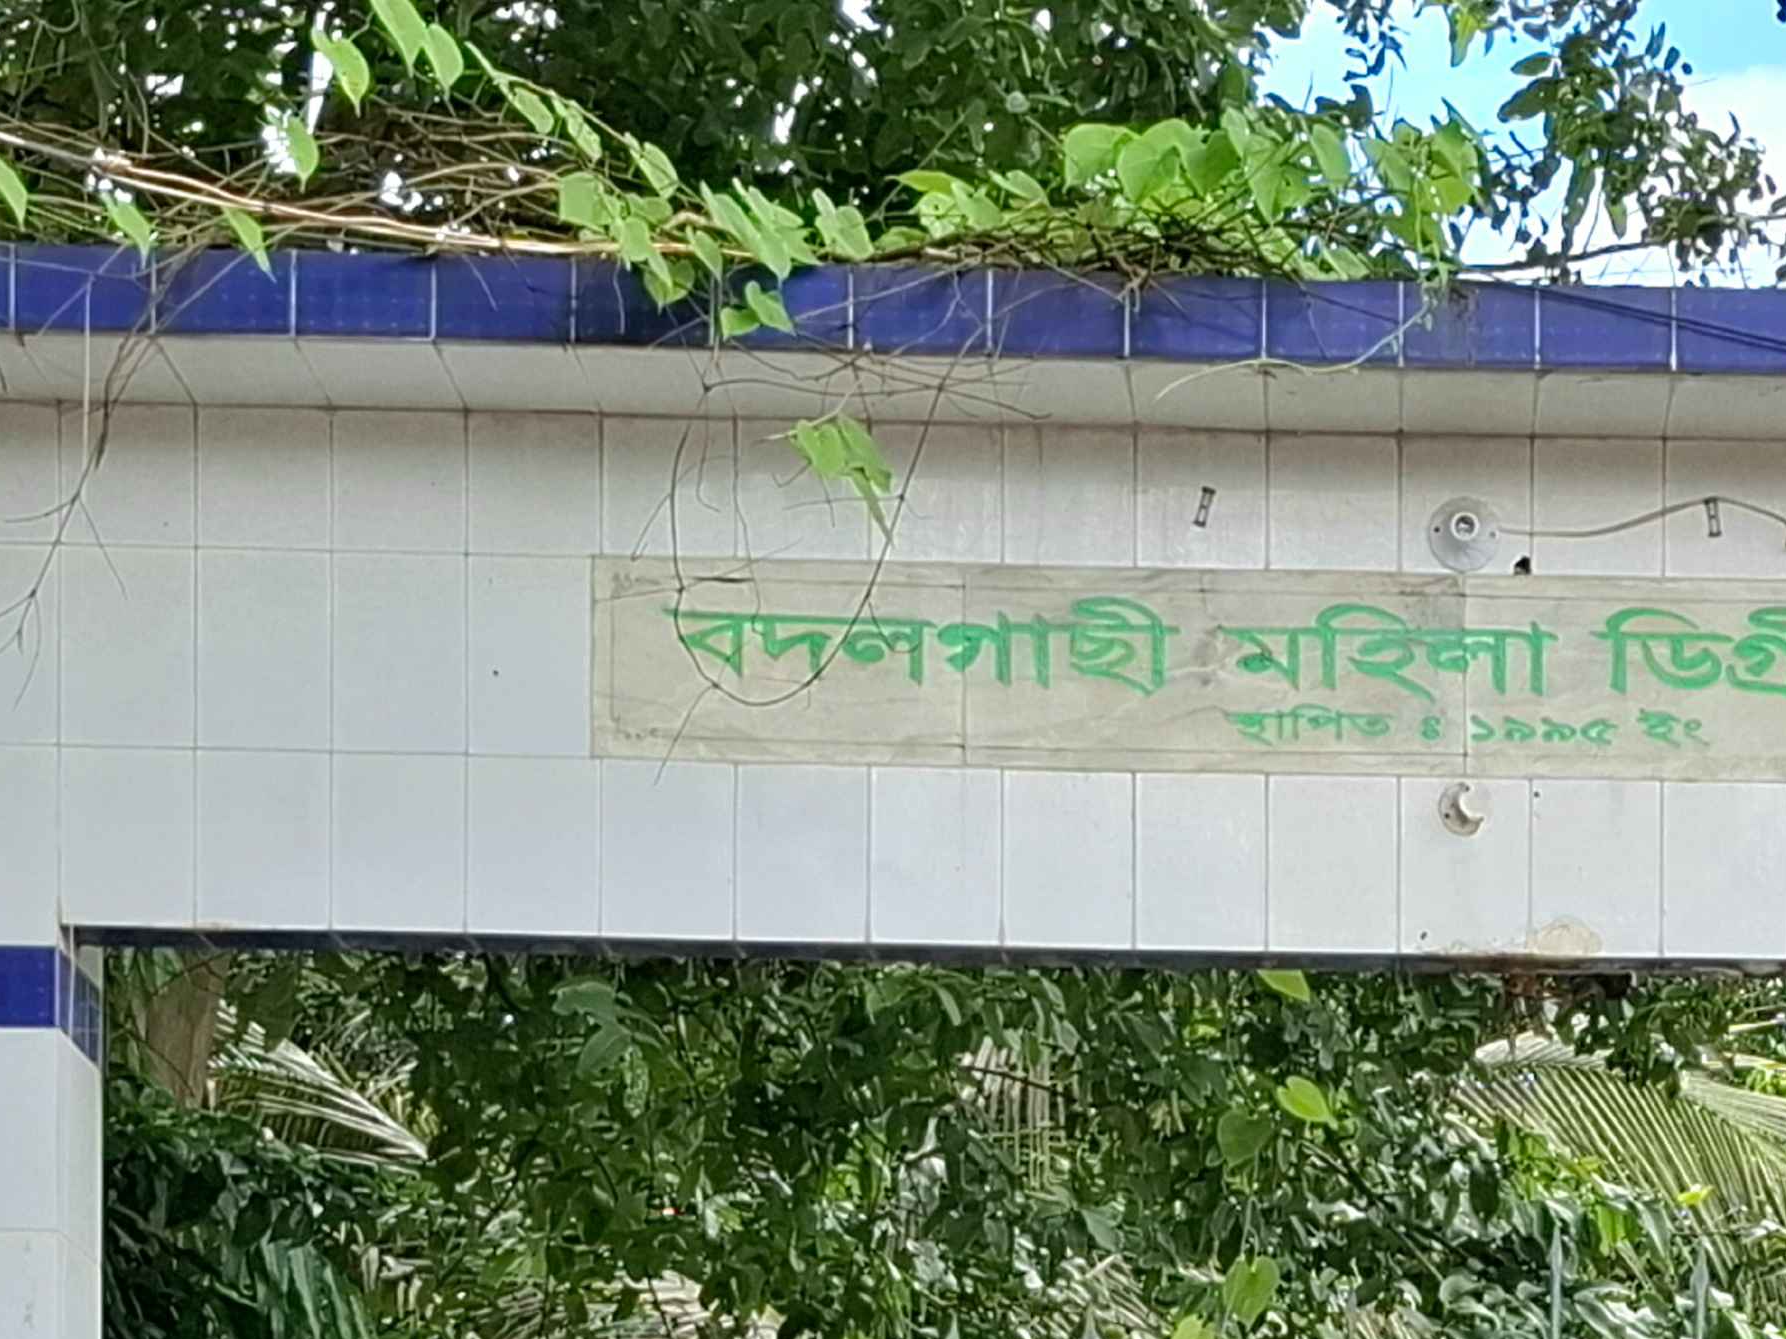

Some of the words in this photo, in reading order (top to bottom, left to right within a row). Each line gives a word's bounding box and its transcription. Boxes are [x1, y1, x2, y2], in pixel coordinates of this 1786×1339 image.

[667, 598, 1175, 697] বদলগাছী
[1222, 601, 1549, 697] মহিলা
[1224, 703, 1393, 749] স্থাপিত
[1638, 703, 1710, 752] ইং
